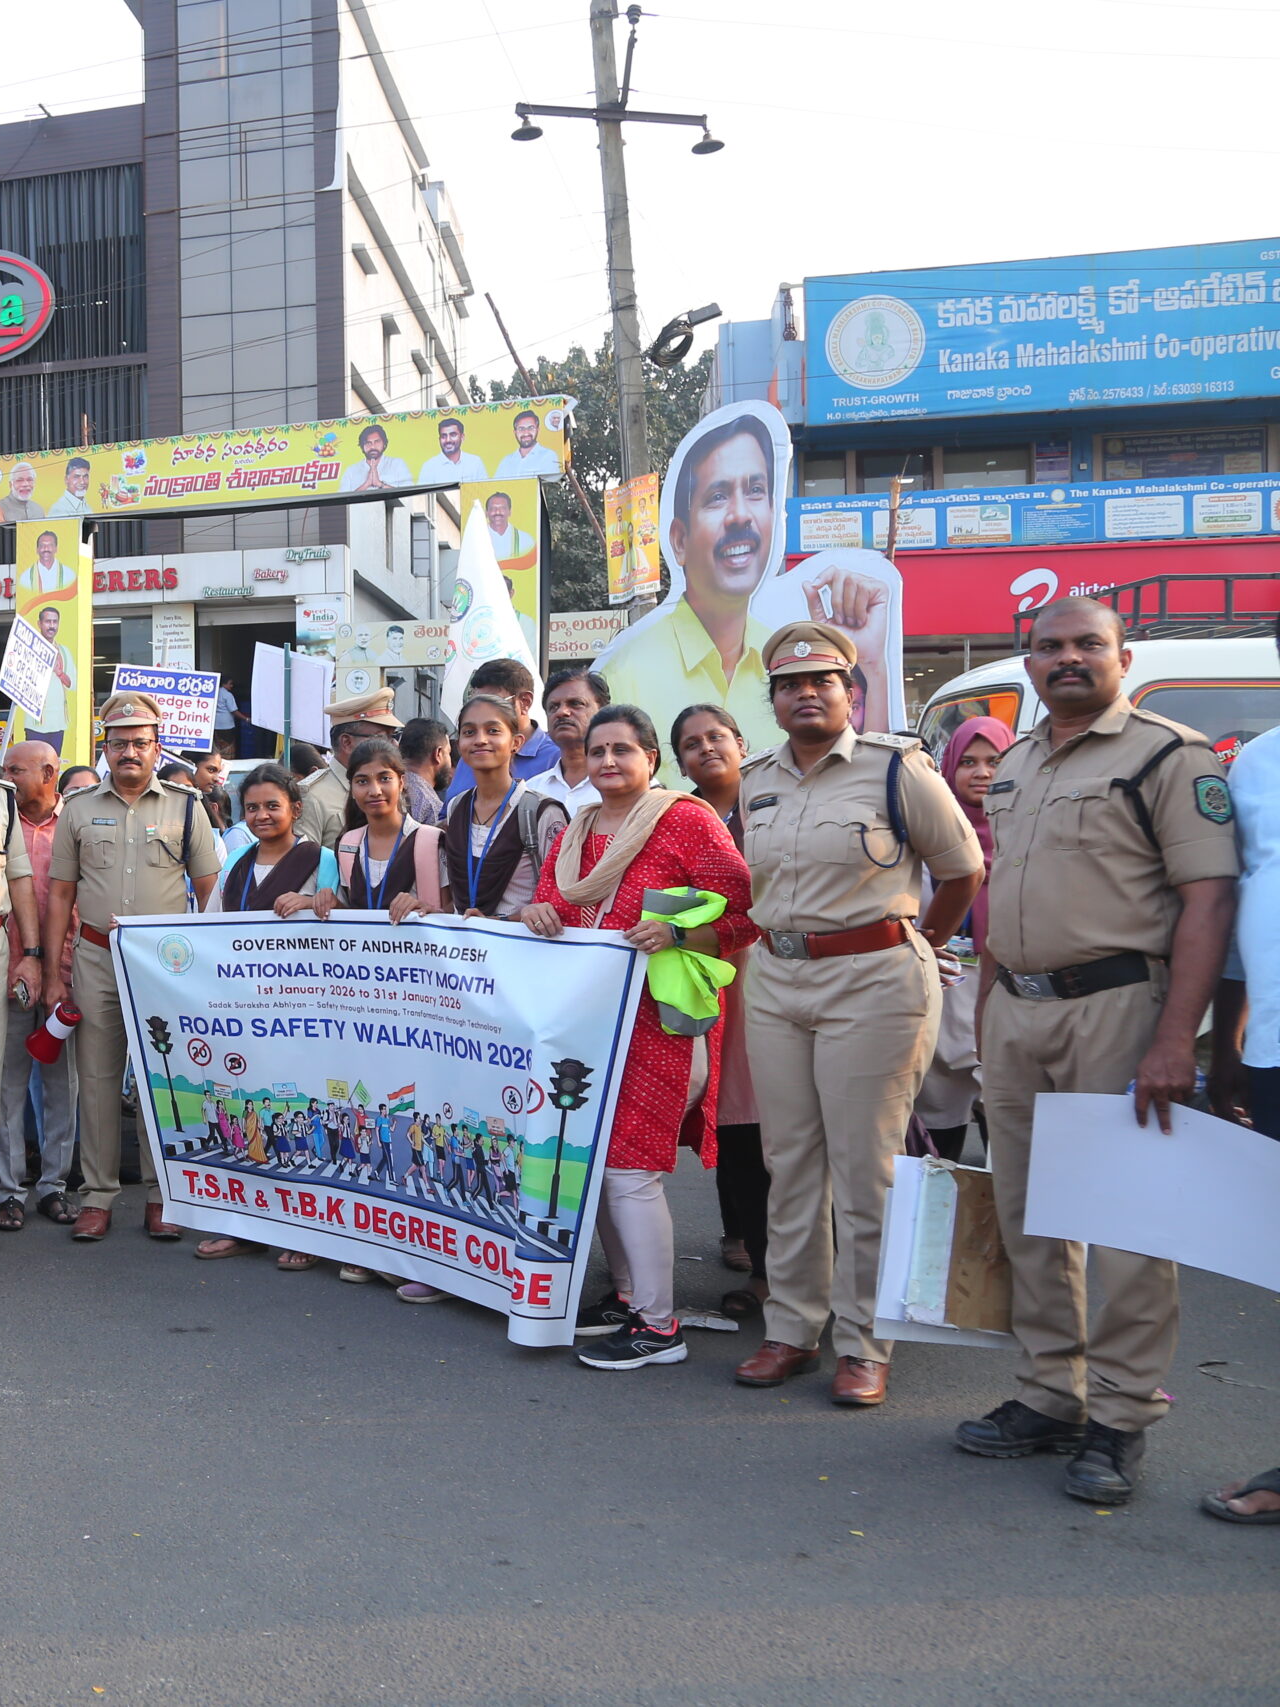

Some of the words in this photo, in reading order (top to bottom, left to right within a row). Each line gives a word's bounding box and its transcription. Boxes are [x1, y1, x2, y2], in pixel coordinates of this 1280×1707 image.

[937, 297, 994, 328] కనక
[939, 348, 1009, 374] Kanaka
[1016, 334, 1147, 369] Mahalakshmi
[832, 393, 920, 408] TRUST-GROWTH
[1103, 387, 1144, 399] 2576433
[1205, 381, 1234, 393] 16313
[172, 443, 217, 466] నూతన
[221, 437, 288, 460] సంవత్సరం
[144, 470, 221, 498] సంక్రాంతి
[226, 460, 341, 491] శుభాకాంక్షలు
[1070, 488, 1089, 498] The
[1092, 486, 1132, 497] Kanaka
[1135, 482, 1207, 495] Mahalakshmi
[93, 568, 178, 593] ERERS
[254, 568, 288, 583] Bakery
[203, 584, 254, 598] Restaurant
[312, 613, 334, 622] India
[119, 671, 175, 690] రహదారి
[178, 676, 214, 696] భద్రత
[197, 699, 209, 709] to
[178, 711, 210, 723] Drink
[170, 725, 202, 736] Drive
[232, 938, 335, 952] GOVERNMENT
[339, 939, 357, 952] OF
[362, 940, 422, 955] ANDHRA
[423, 942, 488, 963] PRADESH
[217, 962, 320, 979] NATIONAL
[322, 962, 370, 981] ROAD
[374, 965, 433, 985] SAFETY
[435, 972, 495, 996] MONTH
[257, 984, 273, 995] 1st
[278, 984, 326, 998] January
[330, 984, 356, 997] 2026
[359, 988, 370, 998] to
[373, 987, 397, 1001] 31st
[401, 990, 437, 1007] January
[439, 996, 462, 1010] 2026
[208, 1001, 232, 1009] Sadak
[234, 1001, 270, 1009] Suraksha
[273, 1001, 307, 1011] Abhiyan
[317, 1001, 338, 1012] Safety
[340, 1002, 365, 1014] through
[367, 1006, 401, 1017] Learning,
[445, 1015, 466, 1028] through
[467, 1019, 502, 1034] Technology
[178, 1015, 244, 1038] ROAD
[251, 1017, 346, 1040] SAFETY
[353, 1021, 482, 1062] WALKATHON
[182, 1169, 247, 1205] T.S.R
[254, 1189, 269, 1208] &
[275, 1187, 345, 1227] T.B.K
[354, 1202, 459, 1260] DEGREE
